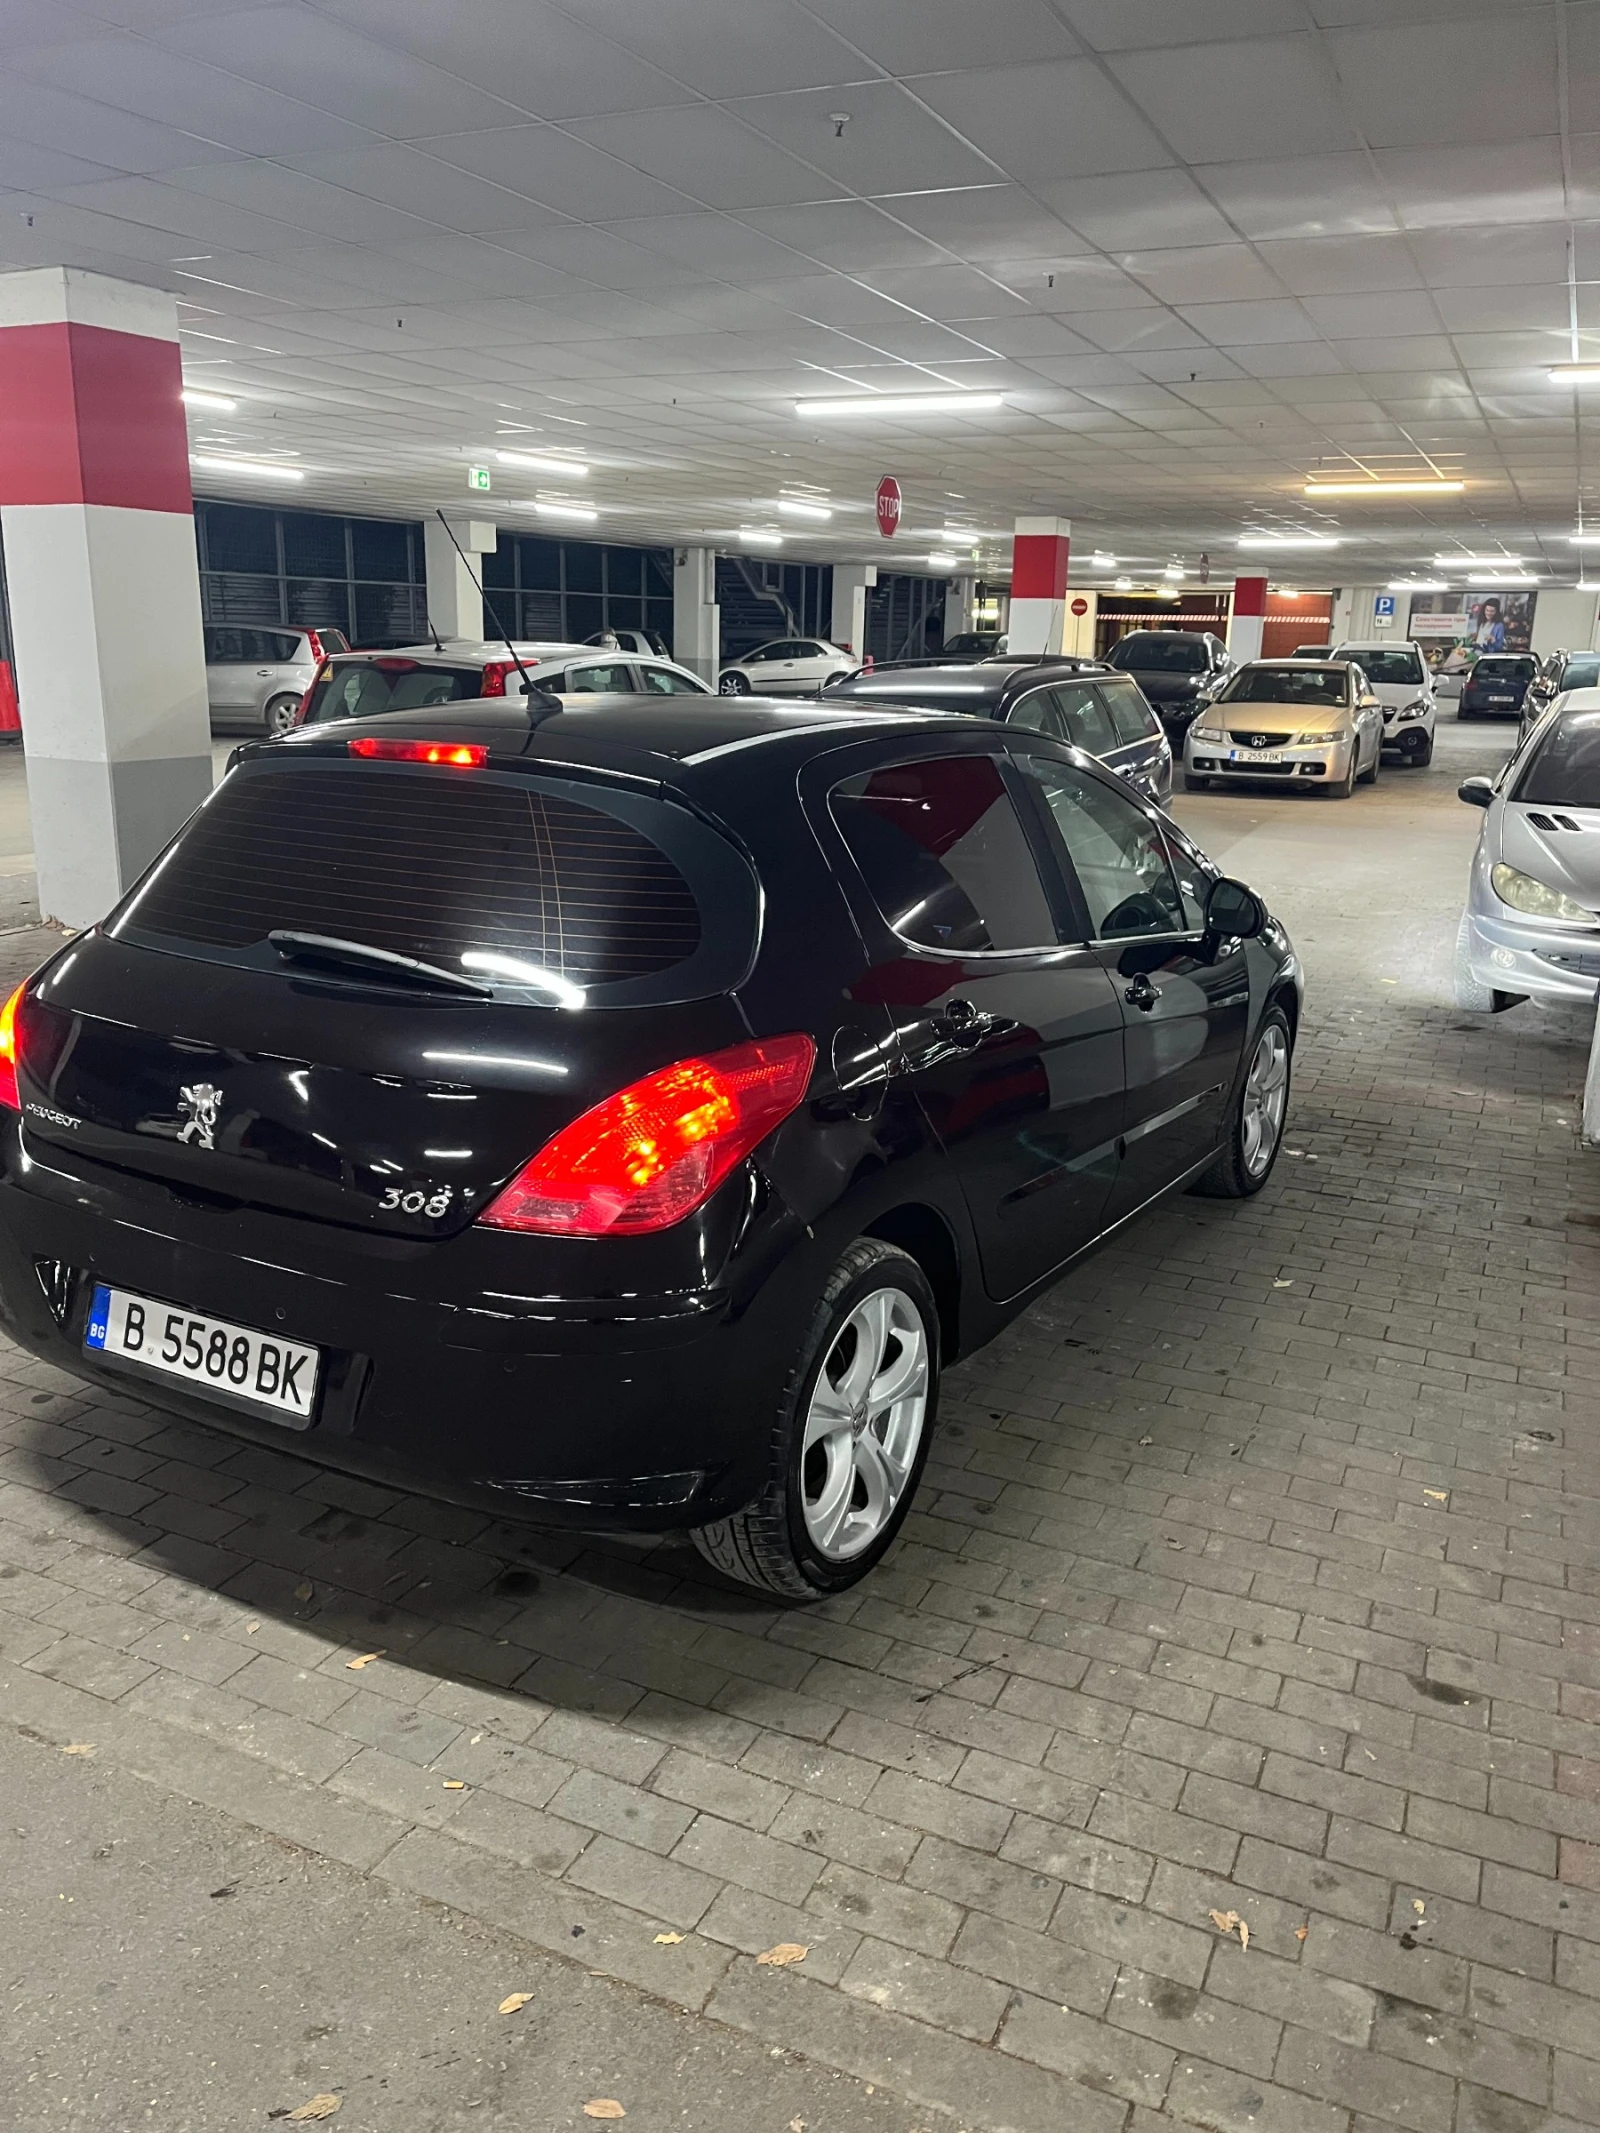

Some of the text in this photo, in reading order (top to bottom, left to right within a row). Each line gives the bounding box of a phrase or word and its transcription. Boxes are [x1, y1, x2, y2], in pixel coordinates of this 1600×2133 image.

[879, 495, 898, 518] STOP
[1379, 598, 1391, 612] P
[1247, 752, 1268, 761] 2559
[26, 1103, 82, 1130] PEUGEOT
[379, 1187, 450, 1218] 308
[90, 1322, 105, 1340] BG
[123, 1302, 309, 1405] B 5588 BK
